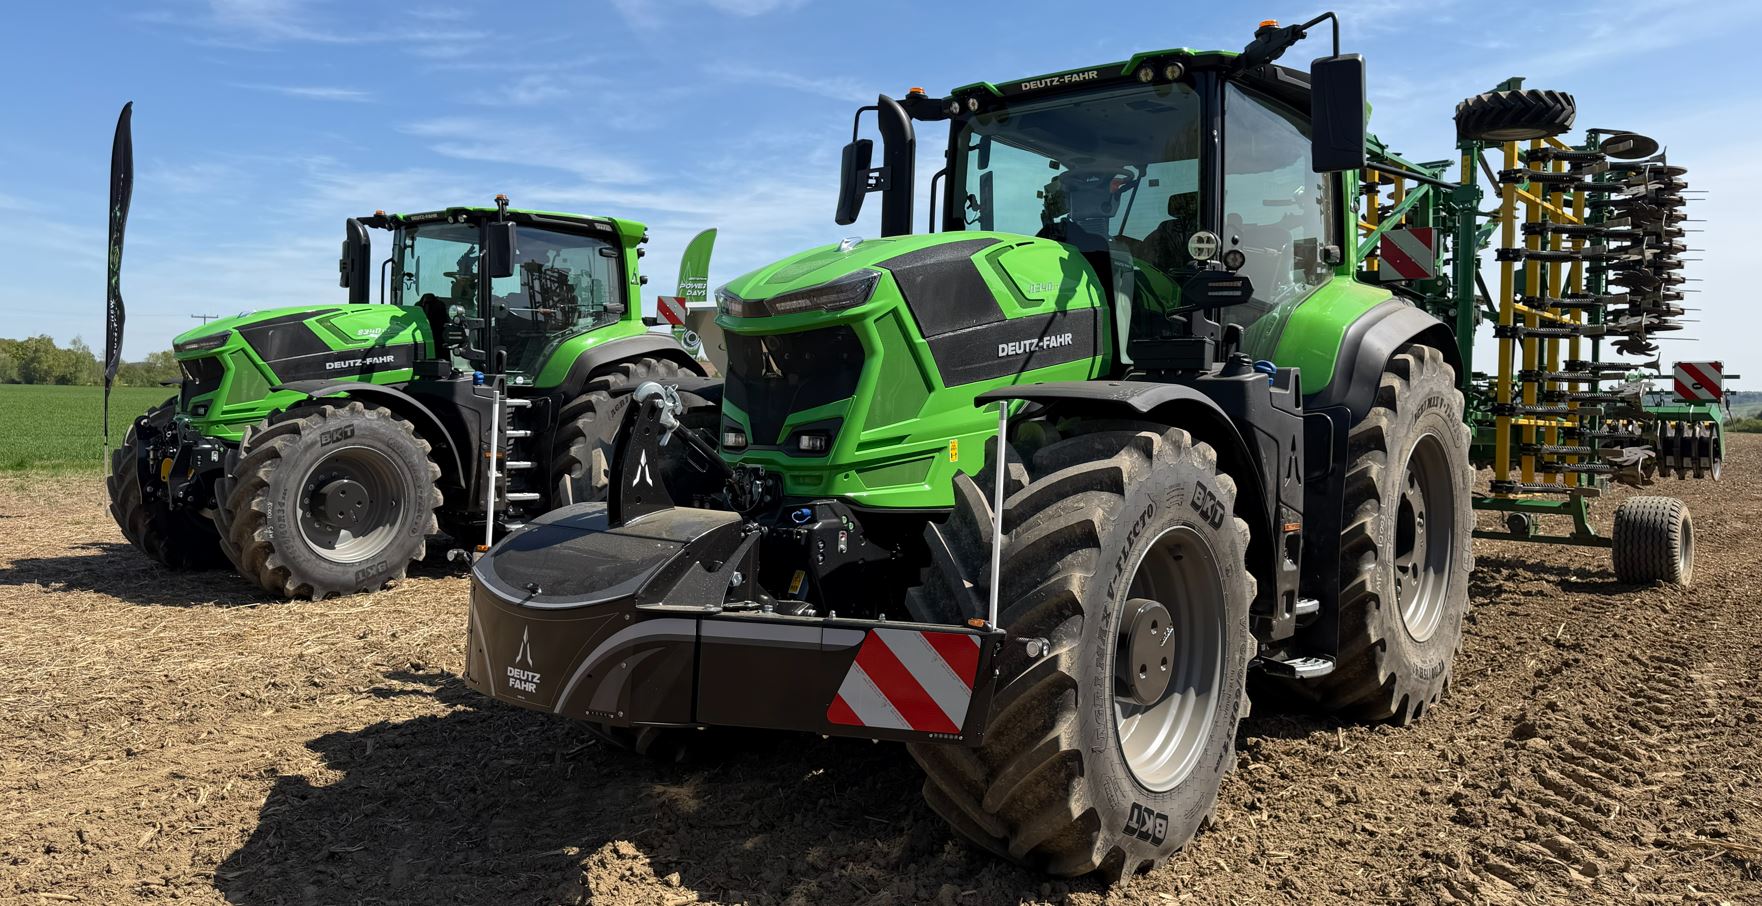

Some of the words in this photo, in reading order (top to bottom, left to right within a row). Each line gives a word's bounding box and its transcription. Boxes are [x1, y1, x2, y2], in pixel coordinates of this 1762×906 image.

[1021, 70, 1098, 91] DEUTZ-FAHR
[998, 332, 1072, 357] DEUTZ-FAHR
[325, 355, 395, 370] DEUTZ-FAHR
[320, 424, 355, 447] BKT
[1190, 480, 1226, 532] BKT
[355, 560, 389, 585] BKT
[507, 666, 541, 683] DEUTZ
[509, 677, 537, 693] FAHR
[1122, 801, 1169, 847] BKT
